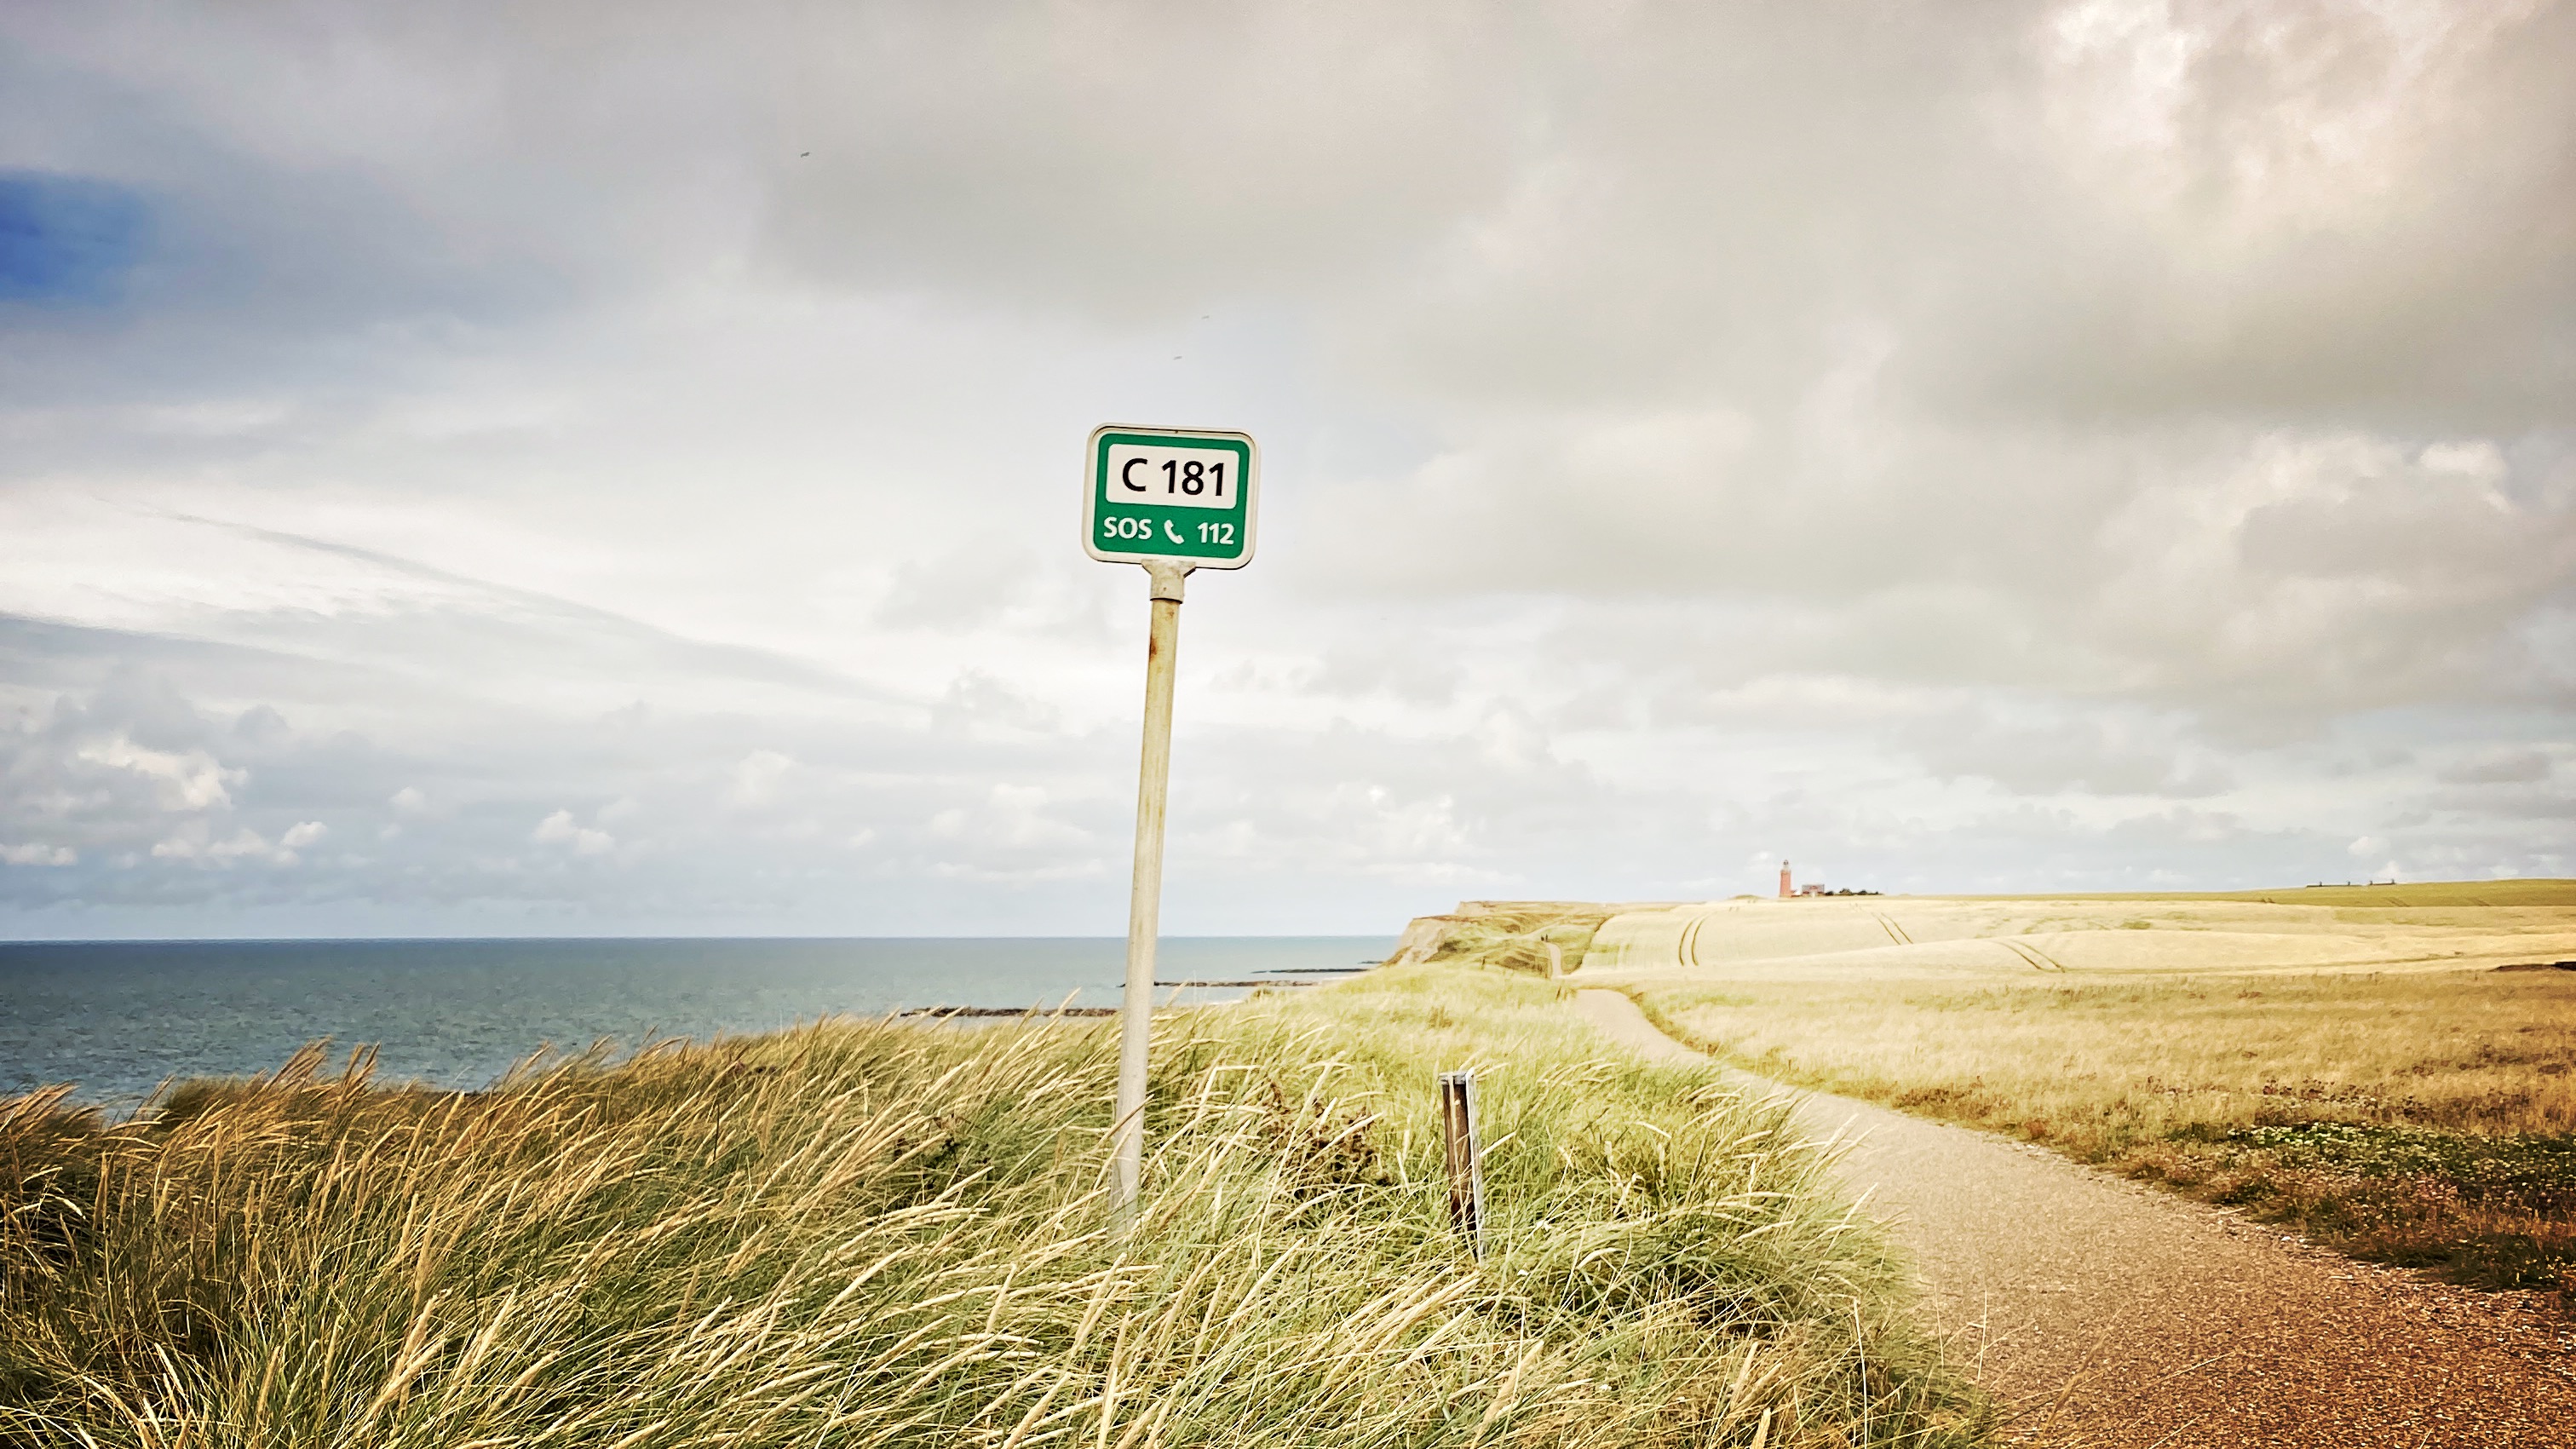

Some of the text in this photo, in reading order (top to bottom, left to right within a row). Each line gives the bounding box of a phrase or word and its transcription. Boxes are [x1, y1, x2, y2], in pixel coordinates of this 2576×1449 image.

[1122, 457, 1225, 497] C 181
[1103, 516, 1235, 545] SOS 112
